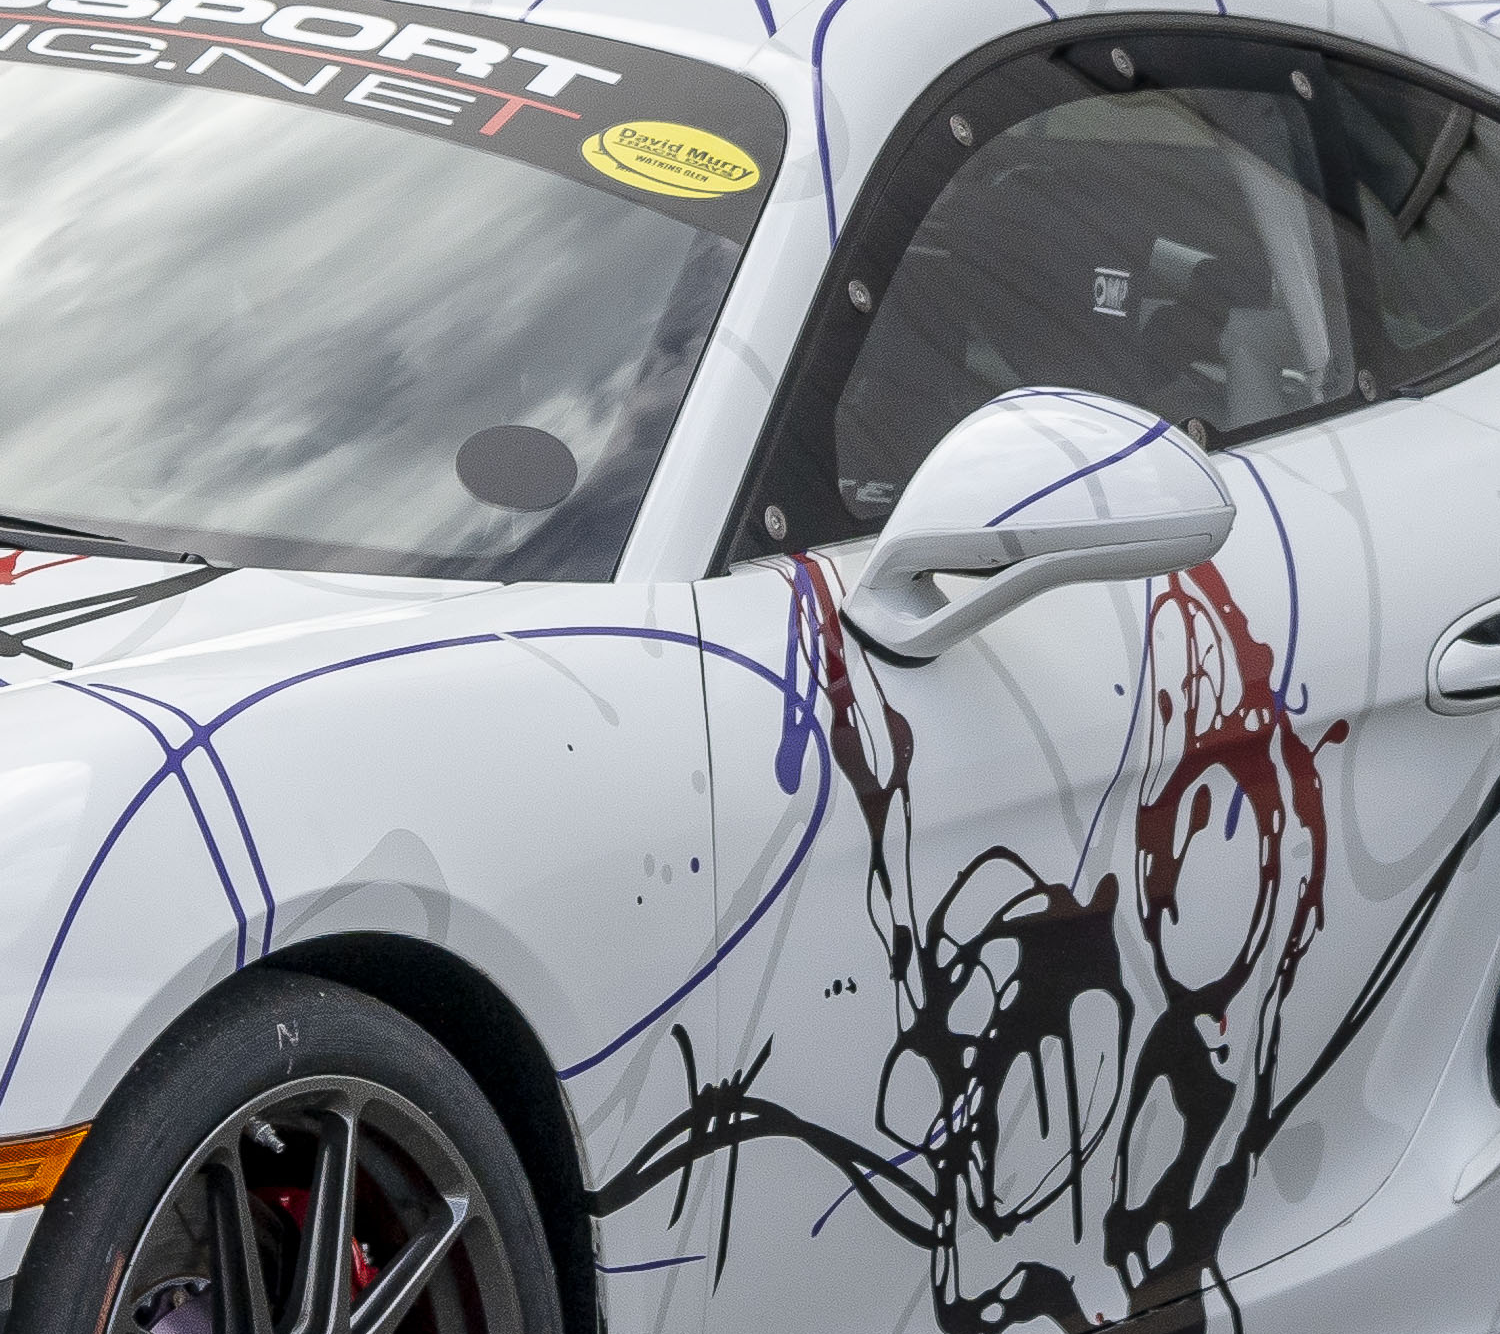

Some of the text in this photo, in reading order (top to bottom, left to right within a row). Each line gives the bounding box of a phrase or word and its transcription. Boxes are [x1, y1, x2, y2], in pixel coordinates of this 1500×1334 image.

[618, 128, 755, 181] David Murry
[635, 154, 683, 175] WATKINS
[682, 169, 709, 183] GLEN
